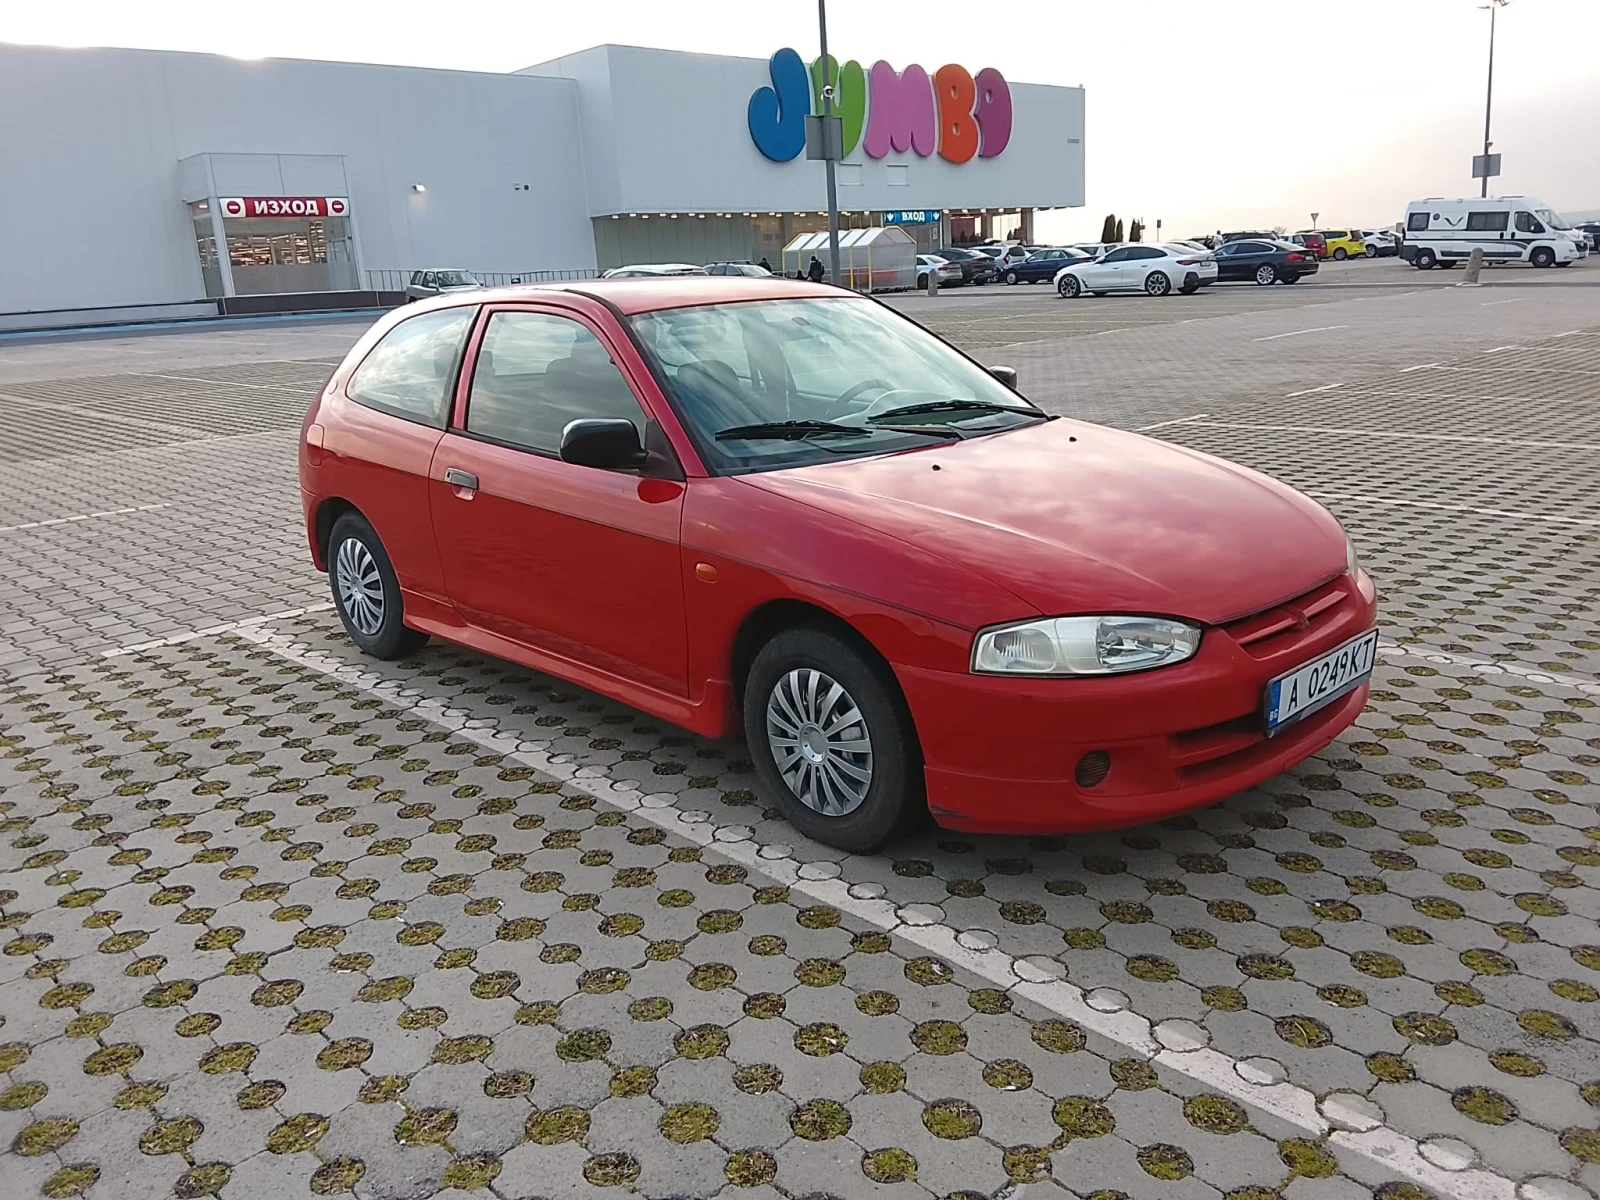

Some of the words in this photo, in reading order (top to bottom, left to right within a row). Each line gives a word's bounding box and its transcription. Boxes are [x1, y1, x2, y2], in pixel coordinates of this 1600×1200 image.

[748, 48, 1012, 164] JUMBO
[253, 200, 319, 216] ИЗХОД
[901, 211, 925, 222] ВХОД
[1287, 678, 1298, 713] A
[1269, 708, 1278, 721] BG
